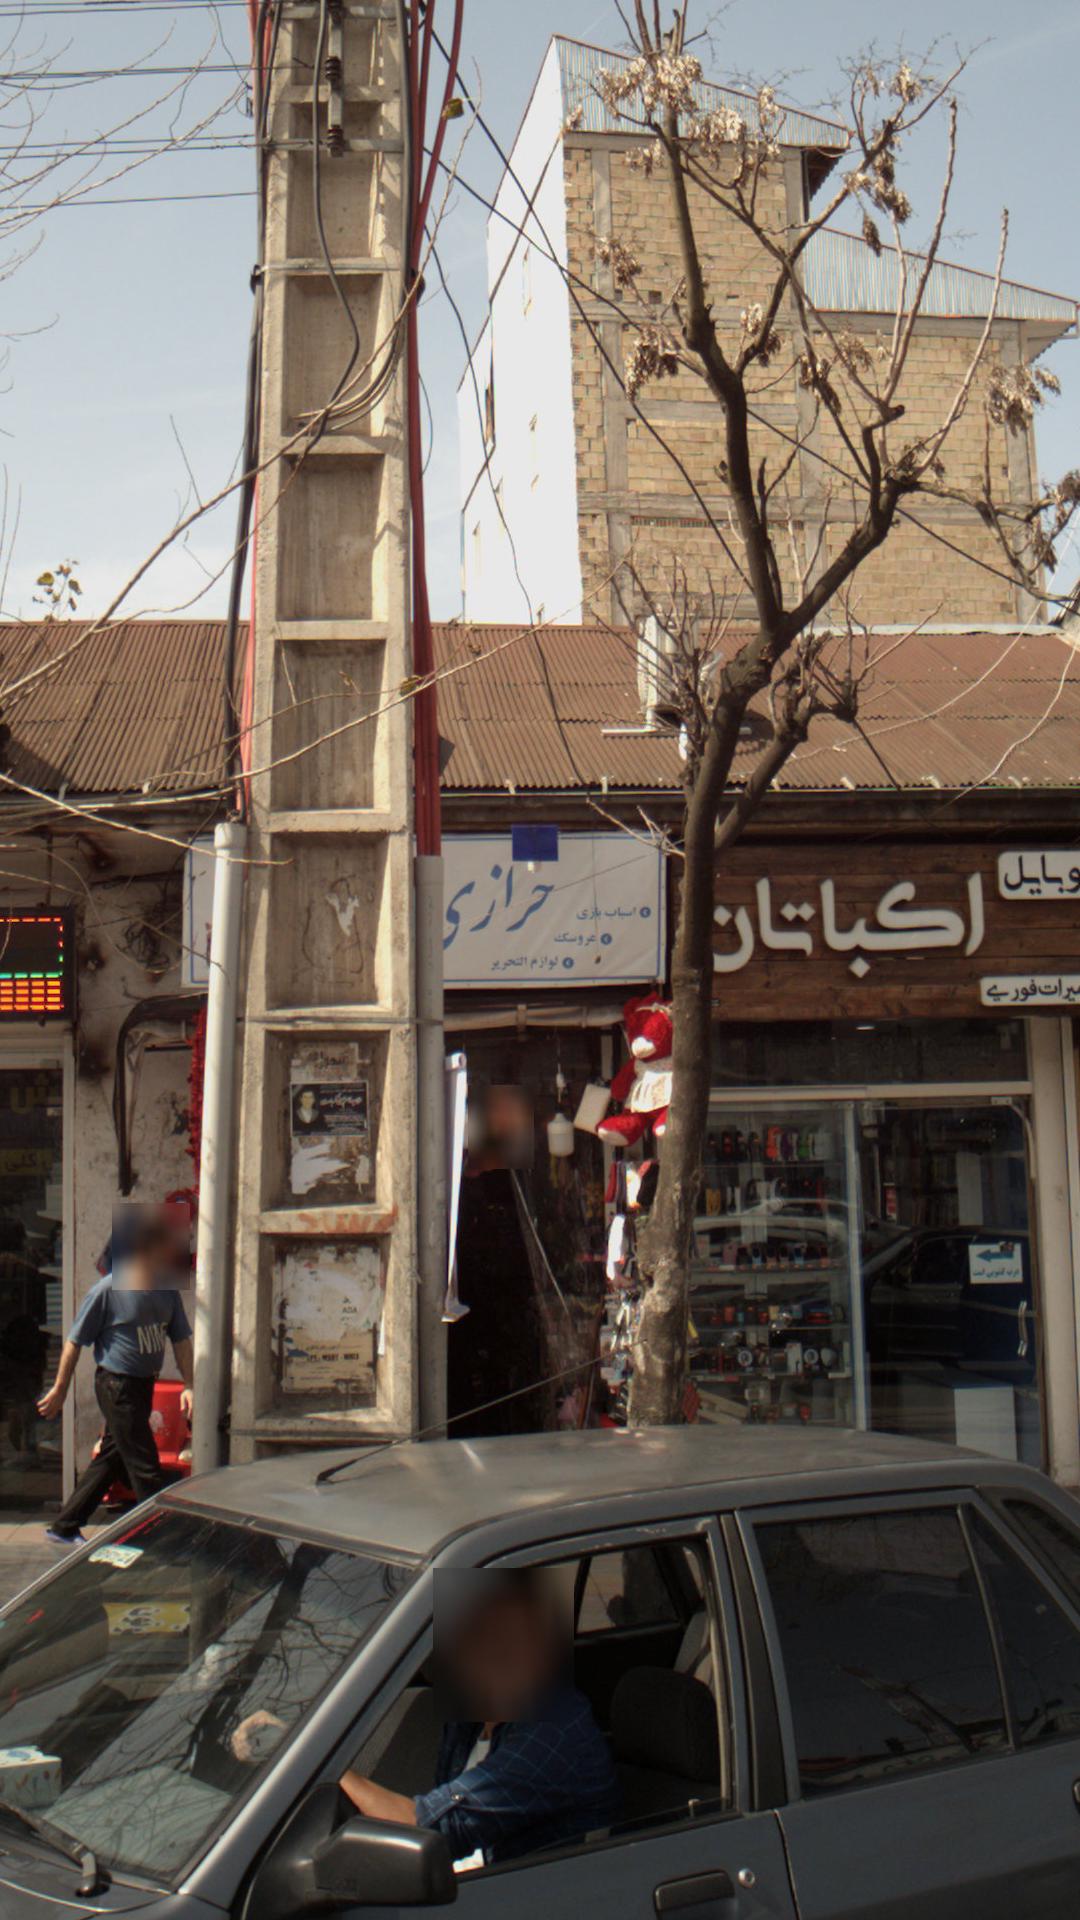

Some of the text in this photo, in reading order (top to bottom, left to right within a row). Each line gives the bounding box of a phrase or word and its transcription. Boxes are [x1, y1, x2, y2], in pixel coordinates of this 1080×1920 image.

[1004, 854, 1080, 895] وبایل
[576, 906, 637, 920] اسباب بازی
[713, 872, 986, 978] اکباتان
[554, 931, 596, 946] عروسک
[491, 956, 558, 971] لوازم التحریر
